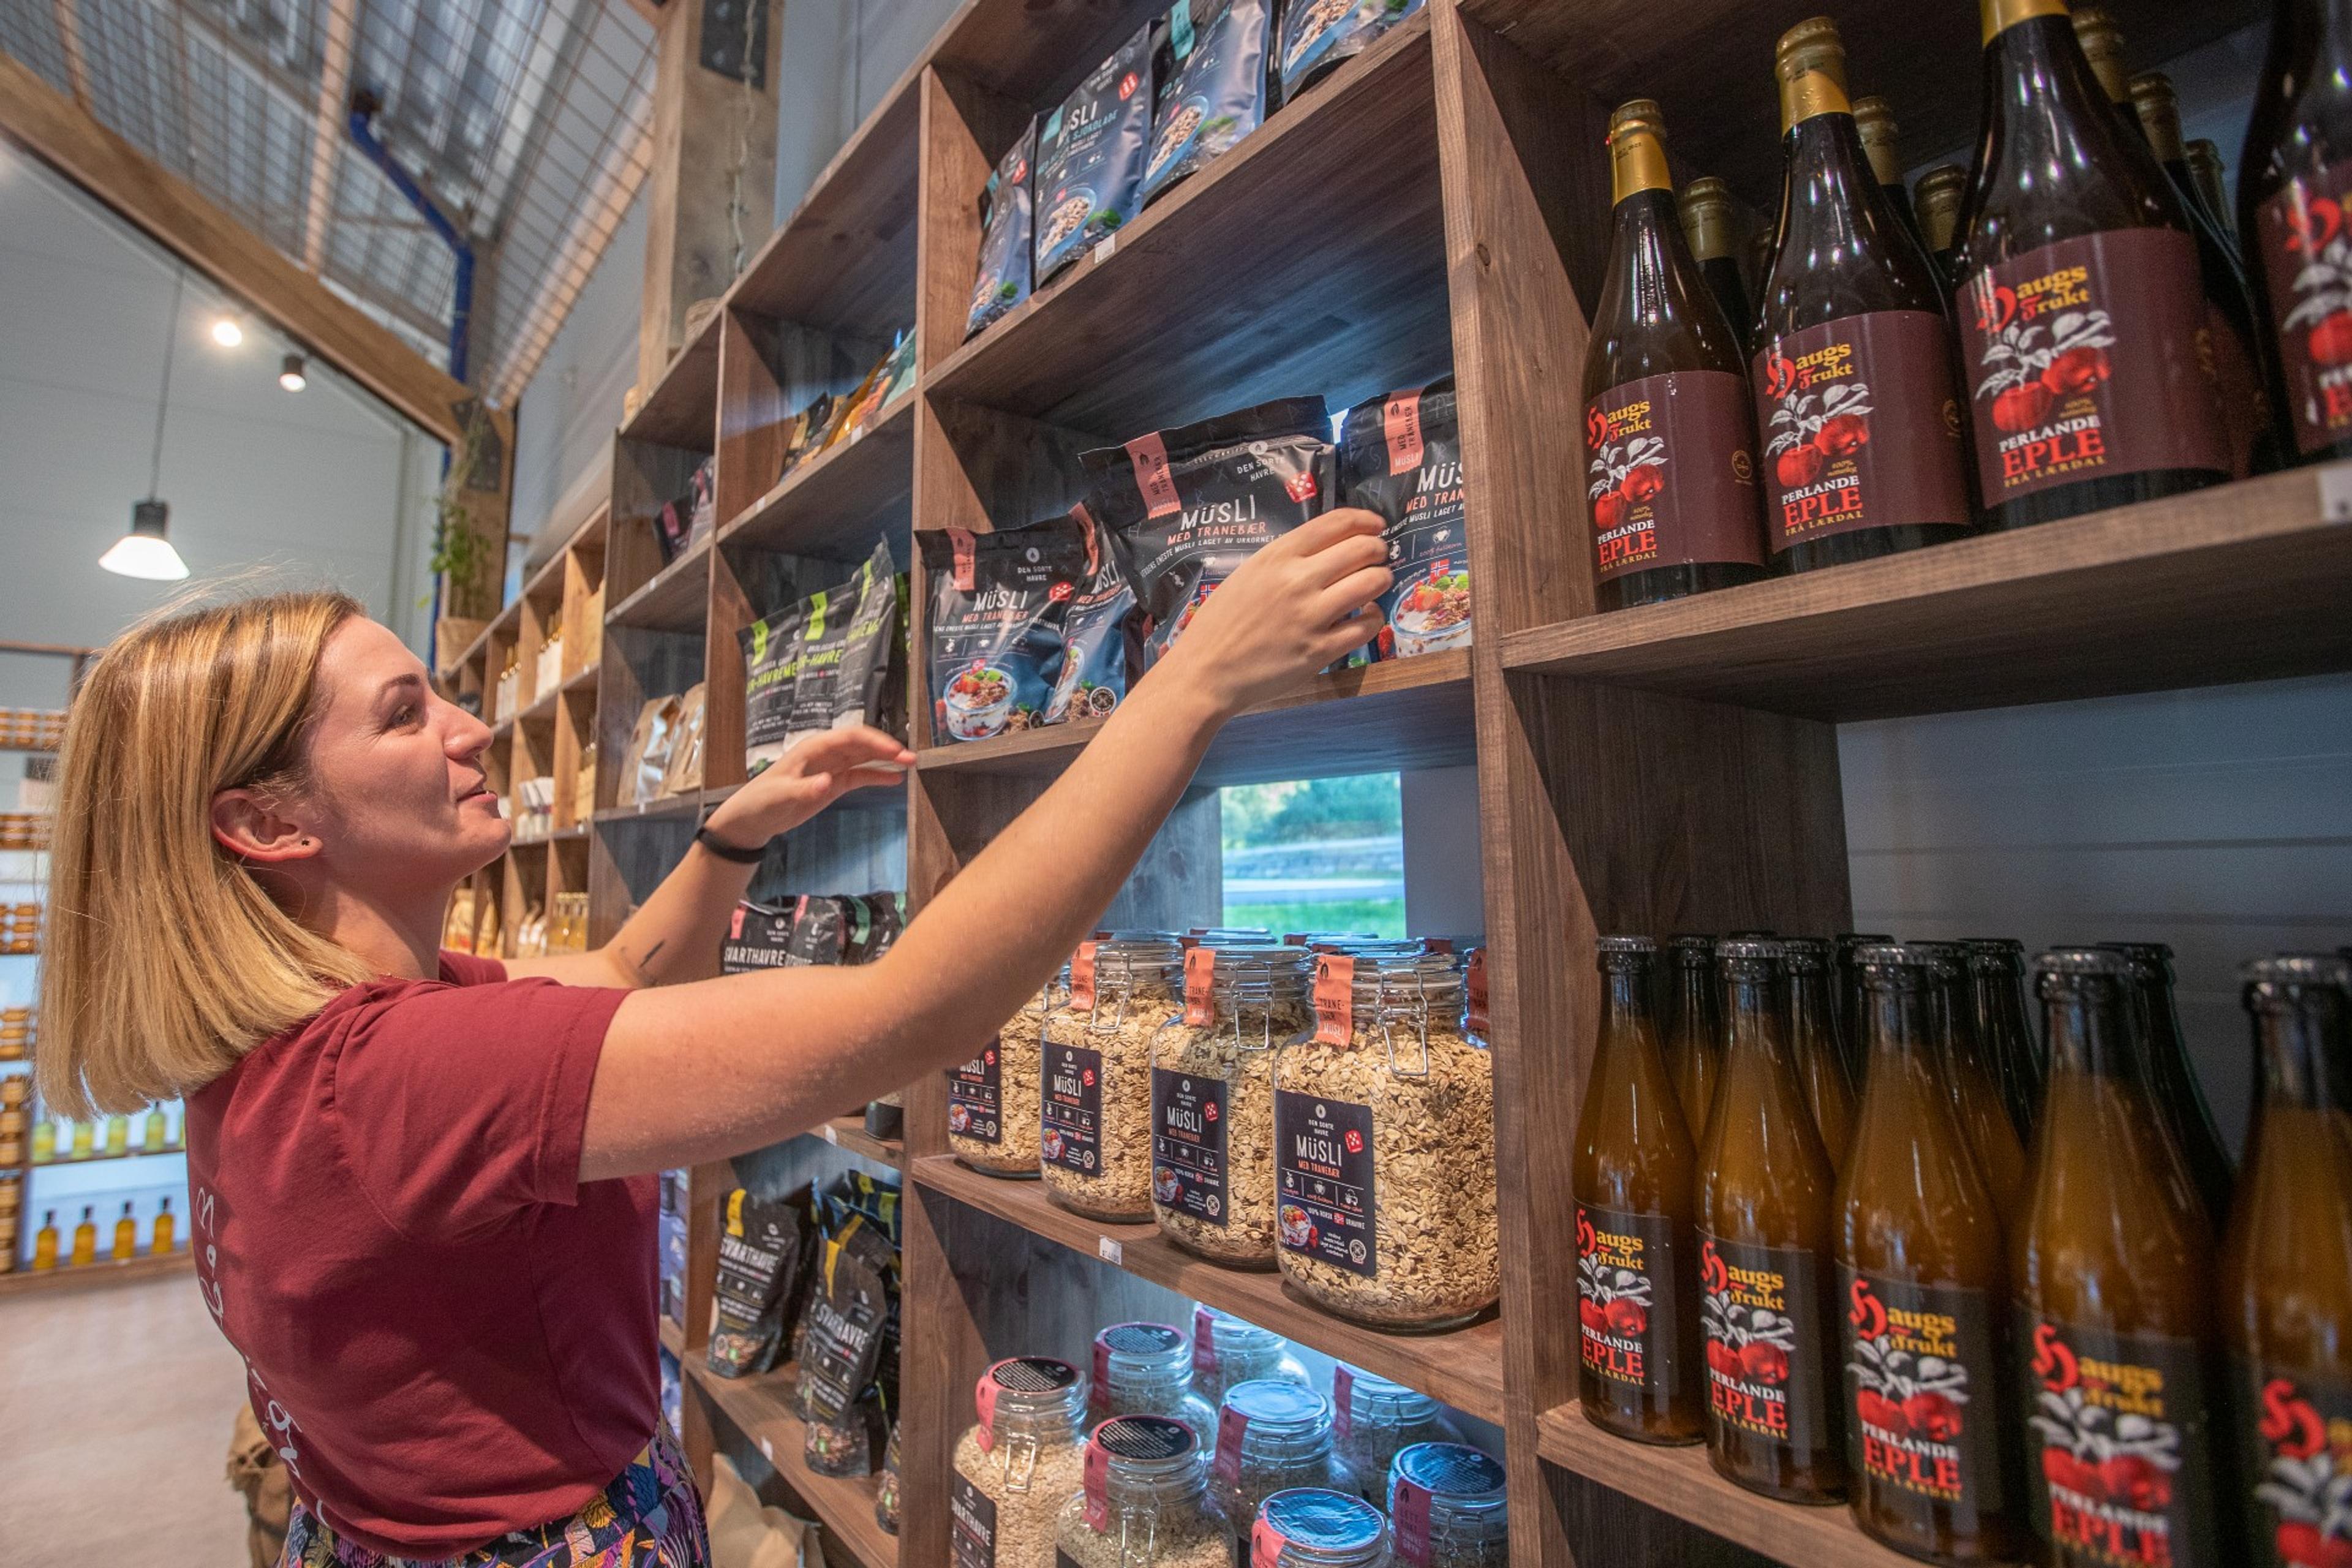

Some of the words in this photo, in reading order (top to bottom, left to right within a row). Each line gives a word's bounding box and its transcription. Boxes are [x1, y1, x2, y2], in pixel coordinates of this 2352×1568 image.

[2021, 288, 2090, 320] Frukt
[1766, 342, 1852, 400] Haugs
[1798, 363, 1853, 389] Frukt
[1588, 400, 1651, 451] Haugs
[1608, 418, 1653, 442] Frukt
[1999, 415, 2101, 453] PERLANDE
[1237, 464, 1254, 474] DEN
[1395, 453, 1419, 467] MÜSLI
[2000, 429, 2106, 478] EPLE
[1250, 466, 1275, 481] HAVRE
[1405, 495, 1428, 514] MED
[1781, 475, 1860, 505] PERLANDE
[1180, 494, 1256, 531] MÜSLI
[1783, 486, 1863, 528] EPLE
[1808, 510, 1863, 530] LÆRDAL
[1167, 531, 1191, 546] MED
[1197, 521, 1267, 538] TRANEBÆR
[1597, 519, 1655, 545] PERLANDE
[1598, 530, 1657, 565] EPLE
[973, 589, 1029, 611] MÜSLI
[1054, 1074, 1082, 1098] MÜSLI
[1167, 1106, 1202, 1133] MÜSLI
[1295, 1134, 1343, 1167] MÜSLI
[1577, 1208, 1643, 1258] Haugs
[1597, 1246, 1645, 1270] Frukt
[1701, 1241, 1785, 1295] Haugs
[1730, 1282, 1785, 1311] Frukt
[1849, 1279, 1957, 1341] Haugs
[1581, 1323, 1643, 1354] PERLANDE
[1888, 1325, 1957, 1359] Frukt
[1582, 1334, 1645, 1378] EPLE
[1710, 1366, 1786, 1403] PERLANDE
[1711, 1379, 1789, 1431] EPLE
[1861, 1419, 1959, 1462] PERLANDE
[1863, 1433, 1963, 1491] EPLE
